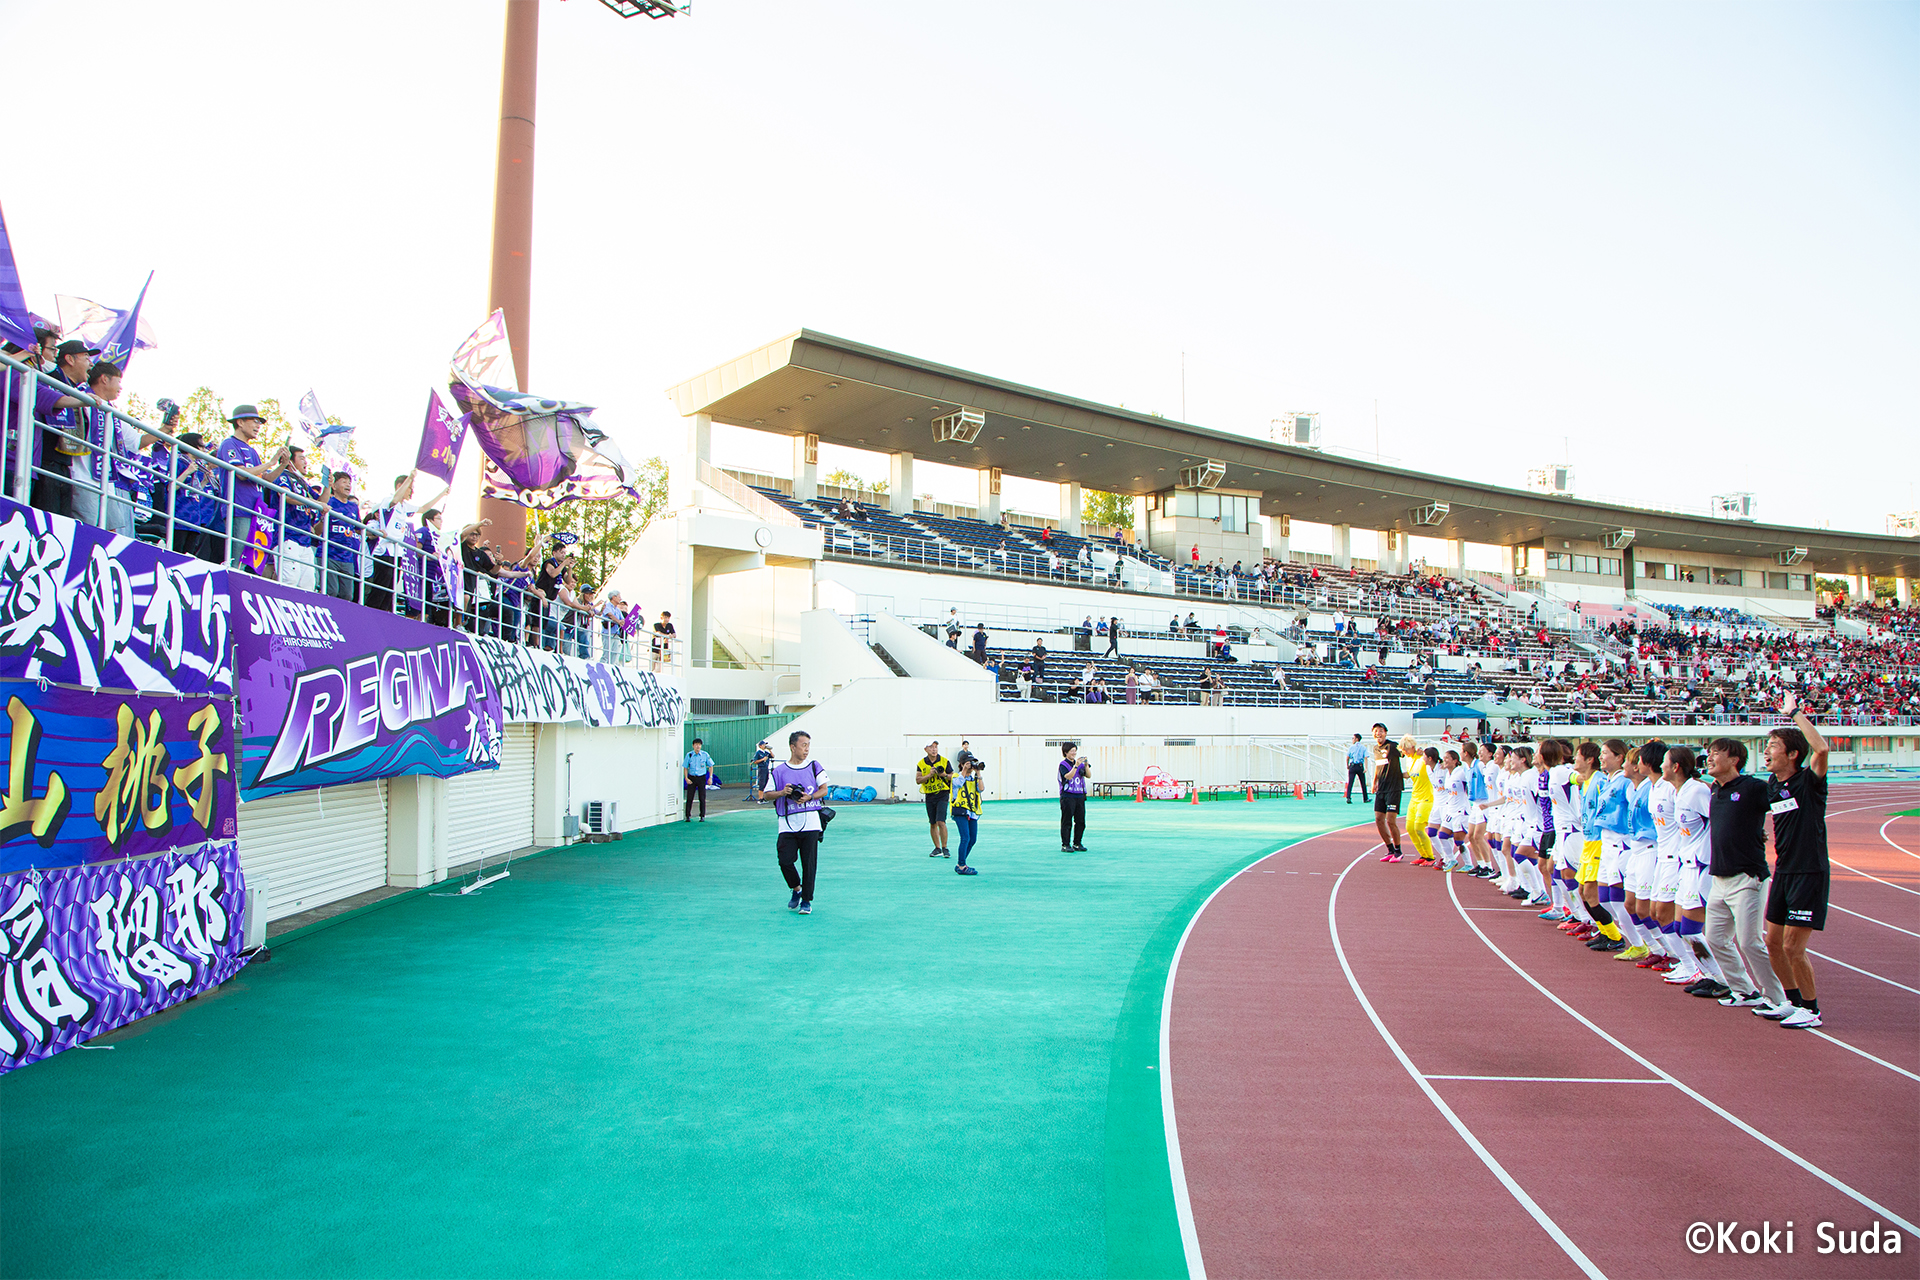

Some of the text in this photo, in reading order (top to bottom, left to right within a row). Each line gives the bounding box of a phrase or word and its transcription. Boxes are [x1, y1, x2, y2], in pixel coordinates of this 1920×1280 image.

[241, 590, 346, 642] SANFRECCE
[283, 637, 334, 649] HIROSHIMA FC
[256, 640, 487, 783] REGINA
[465, 709, 502, 765] 広島
